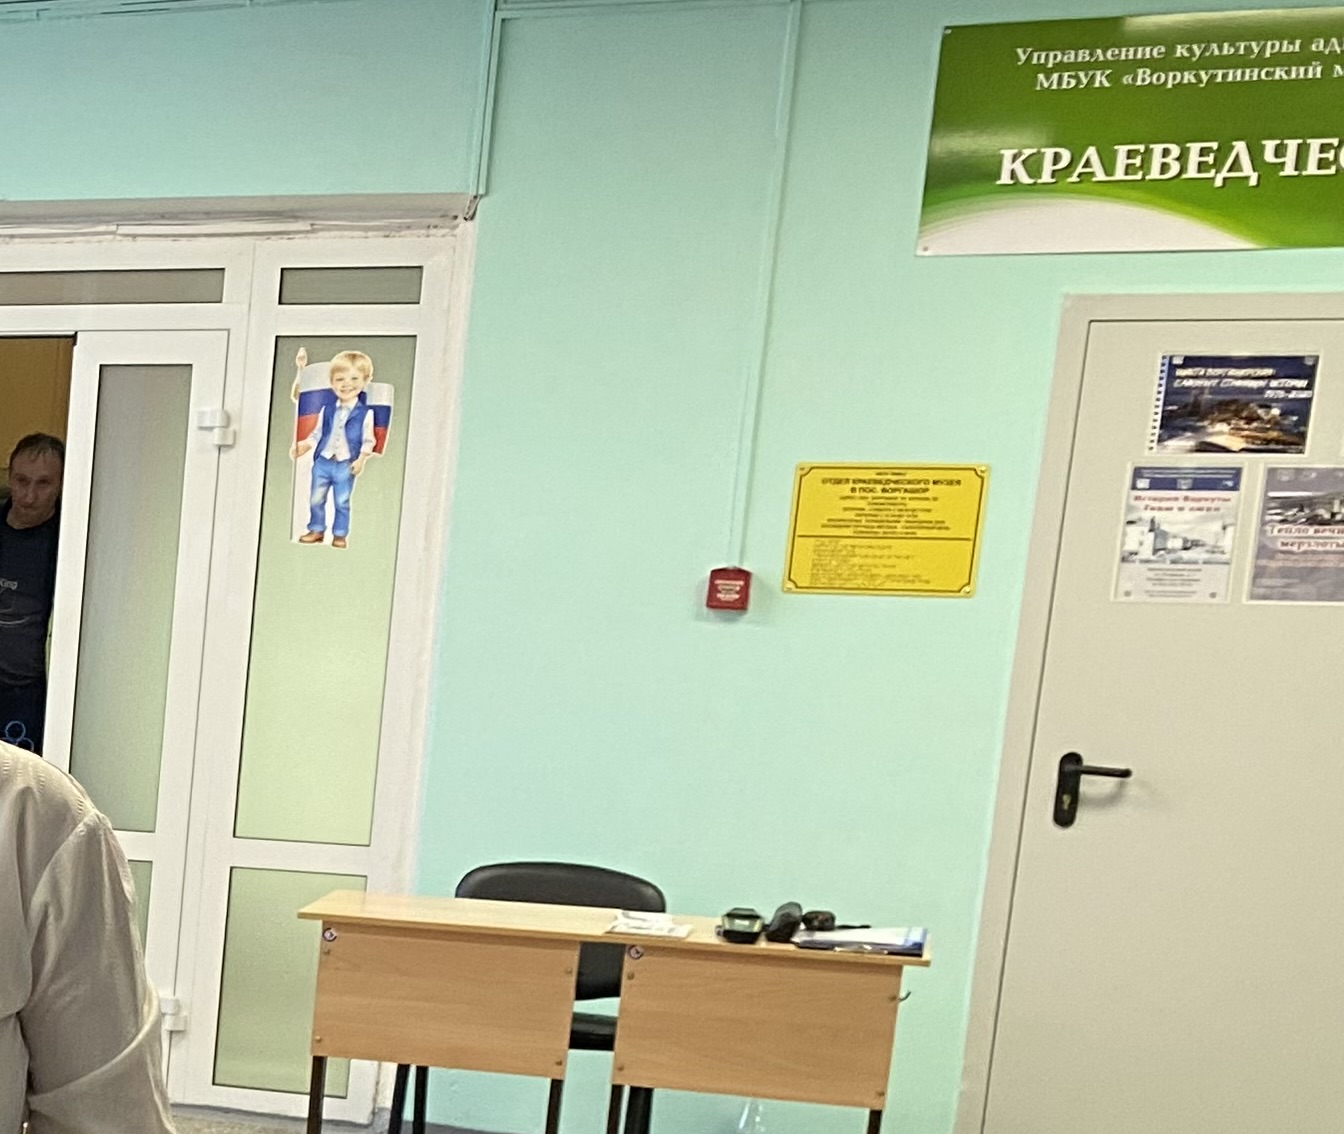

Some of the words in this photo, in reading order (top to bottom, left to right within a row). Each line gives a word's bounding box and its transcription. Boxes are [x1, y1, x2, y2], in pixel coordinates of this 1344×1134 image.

[1015, 44, 1166, 68] Управление
[1175, 38, 1302, 61] культуры
[1311, 37, 1344, 55] ад
[1035, 69, 1113, 90] МБУК
[1121, 61, 1323, 88] «Воркутинский
[994, 137, 1344, 188] КРАЕВЕДЧЕ
